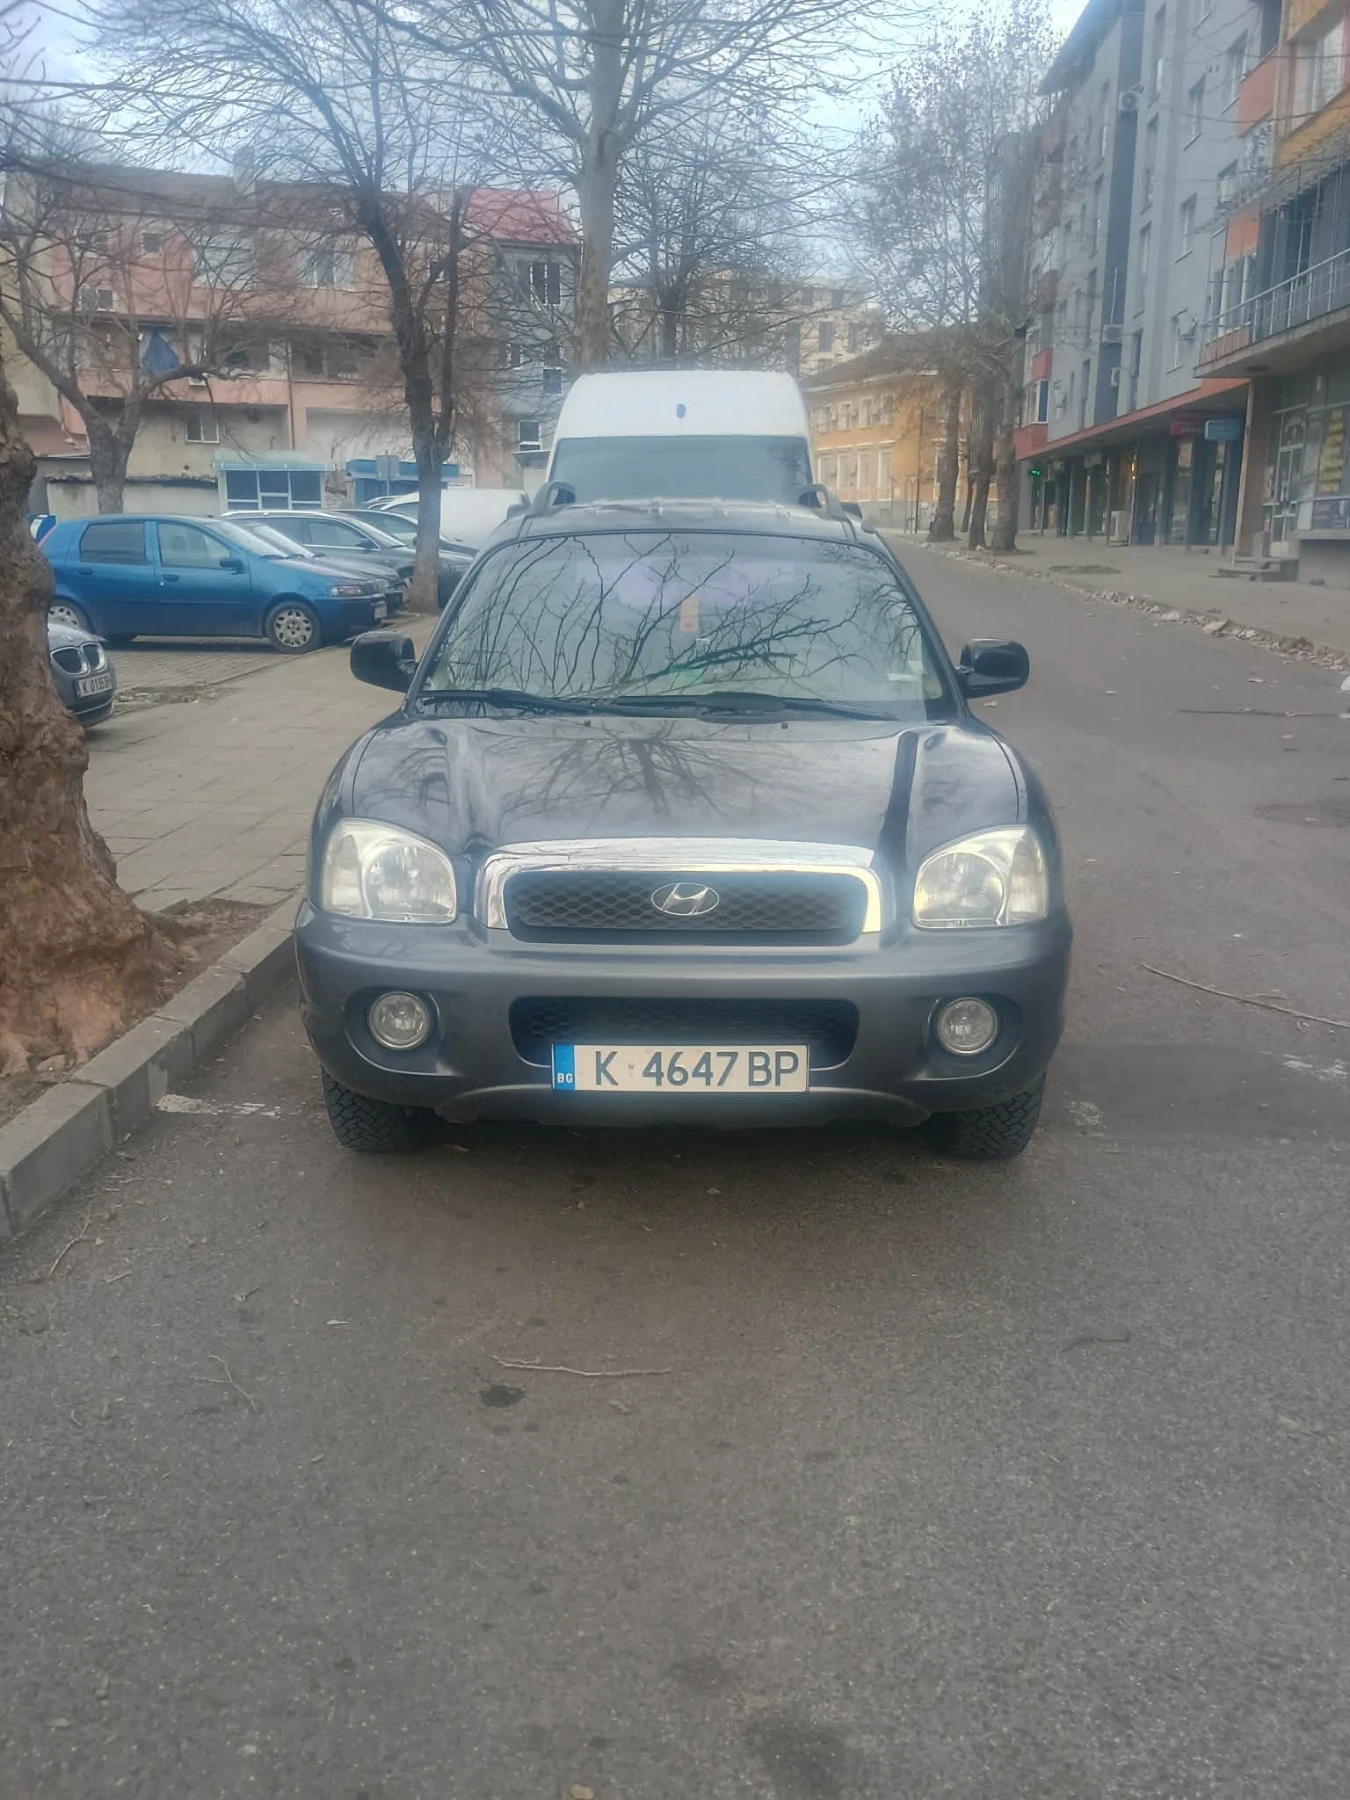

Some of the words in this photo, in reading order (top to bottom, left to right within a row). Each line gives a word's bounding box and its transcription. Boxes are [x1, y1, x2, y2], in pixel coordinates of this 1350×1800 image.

[557, 1073, 574, 1084] BG
[595, 1051, 619, 1087] K
[642, 1051, 739, 1087] 4647
[748, 1051, 799, 1087] BP
